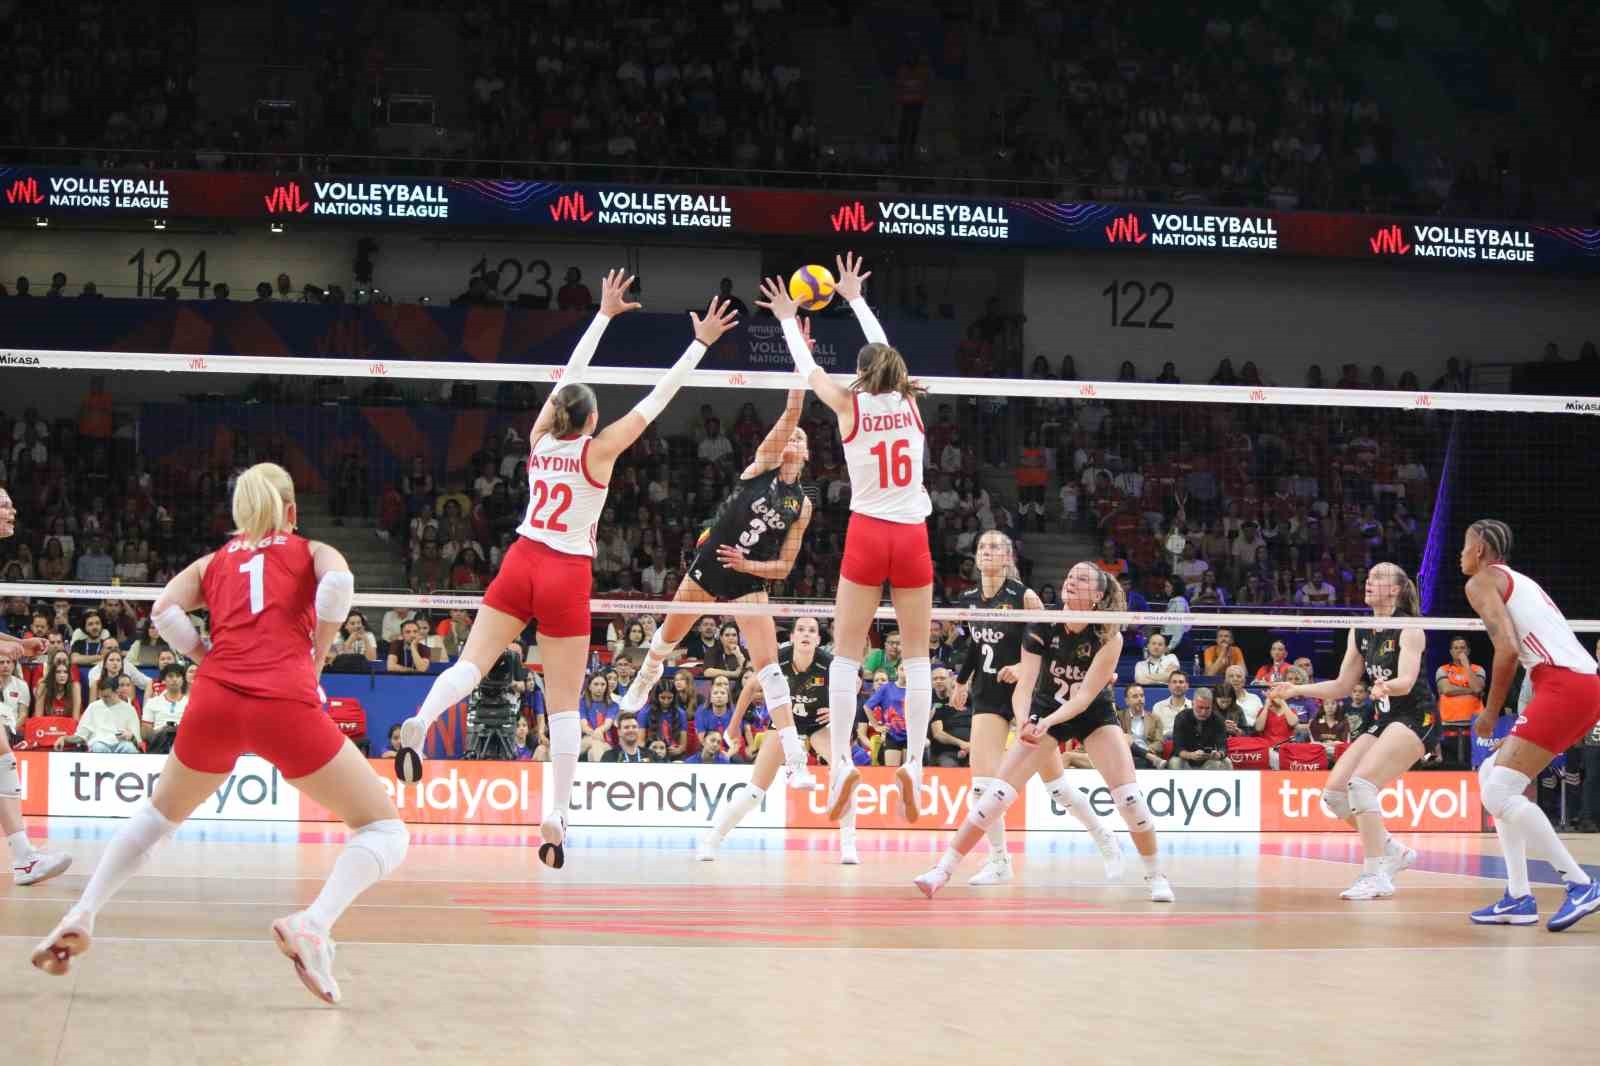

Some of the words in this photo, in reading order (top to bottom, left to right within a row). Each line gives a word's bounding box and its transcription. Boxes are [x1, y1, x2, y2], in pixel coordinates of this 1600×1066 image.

[50, 177, 169, 195] VOLLEYBALL
[314, 182, 448, 203] VOLLEYBALL
[50, 195, 110, 207] NATIONS
[115, 196, 169, 208] LEAGUE
[314, 202, 382, 216] NATIONS
[388, 204, 448, 217] LEAGUE
[599, 191, 731, 212] VOLLEYBALL
[598, 211, 666, 225] NATIONS
[672, 214, 731, 227] LEAGUE
[879, 202, 1008, 224] VOLLEYBALL
[879, 222, 945, 236] NATIONS
[951, 225, 1008, 238] LEAGUE
[1152, 214, 1277, 234] VOLLEYBALL
[1152, 233, 1216, 247] NATIONS
[1221, 236, 1277, 249] LEAGUE
[1414, 225, 1534, 248] VOLLEYBALL
[1414, 245, 1476, 258] NATIONS
[1481, 248, 1534, 262] LEAGUE
[128, 248, 210, 298] 124
[1102, 280, 1175, 328] 122
[748, 325, 783, 333] amazo
[550, 367, 565, 379] VN
[862, 412, 912, 432] ÖZDEN
[531, 455, 580, 473] AYDIN
[870, 439, 912, 489] 16
[530, 479, 573, 532] 22
[739, 518, 767, 547] 3
[239, 553, 264, 615] 1
[971, 626, 1004, 643] lotto
[981, 643, 997, 674] 2
